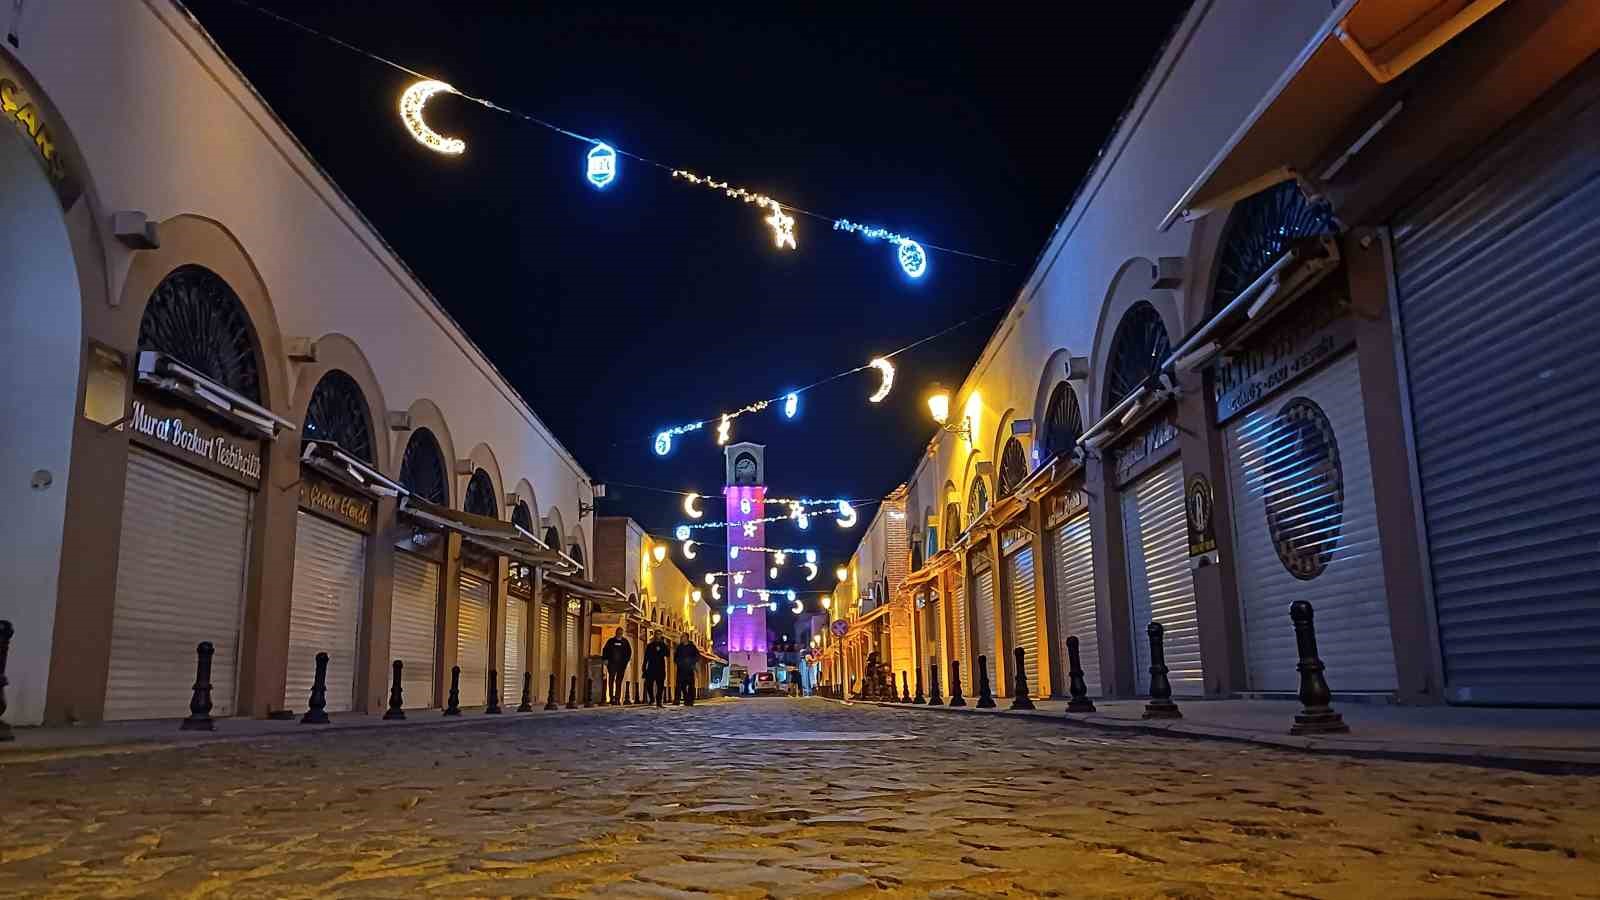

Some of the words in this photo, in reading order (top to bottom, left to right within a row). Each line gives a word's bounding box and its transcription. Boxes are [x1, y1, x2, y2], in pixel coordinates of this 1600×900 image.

[129, 400, 170, 441] Murat
[172, 418, 213, 460] Bozkurt
[215, 437, 262, 481] Tesbihçilik
